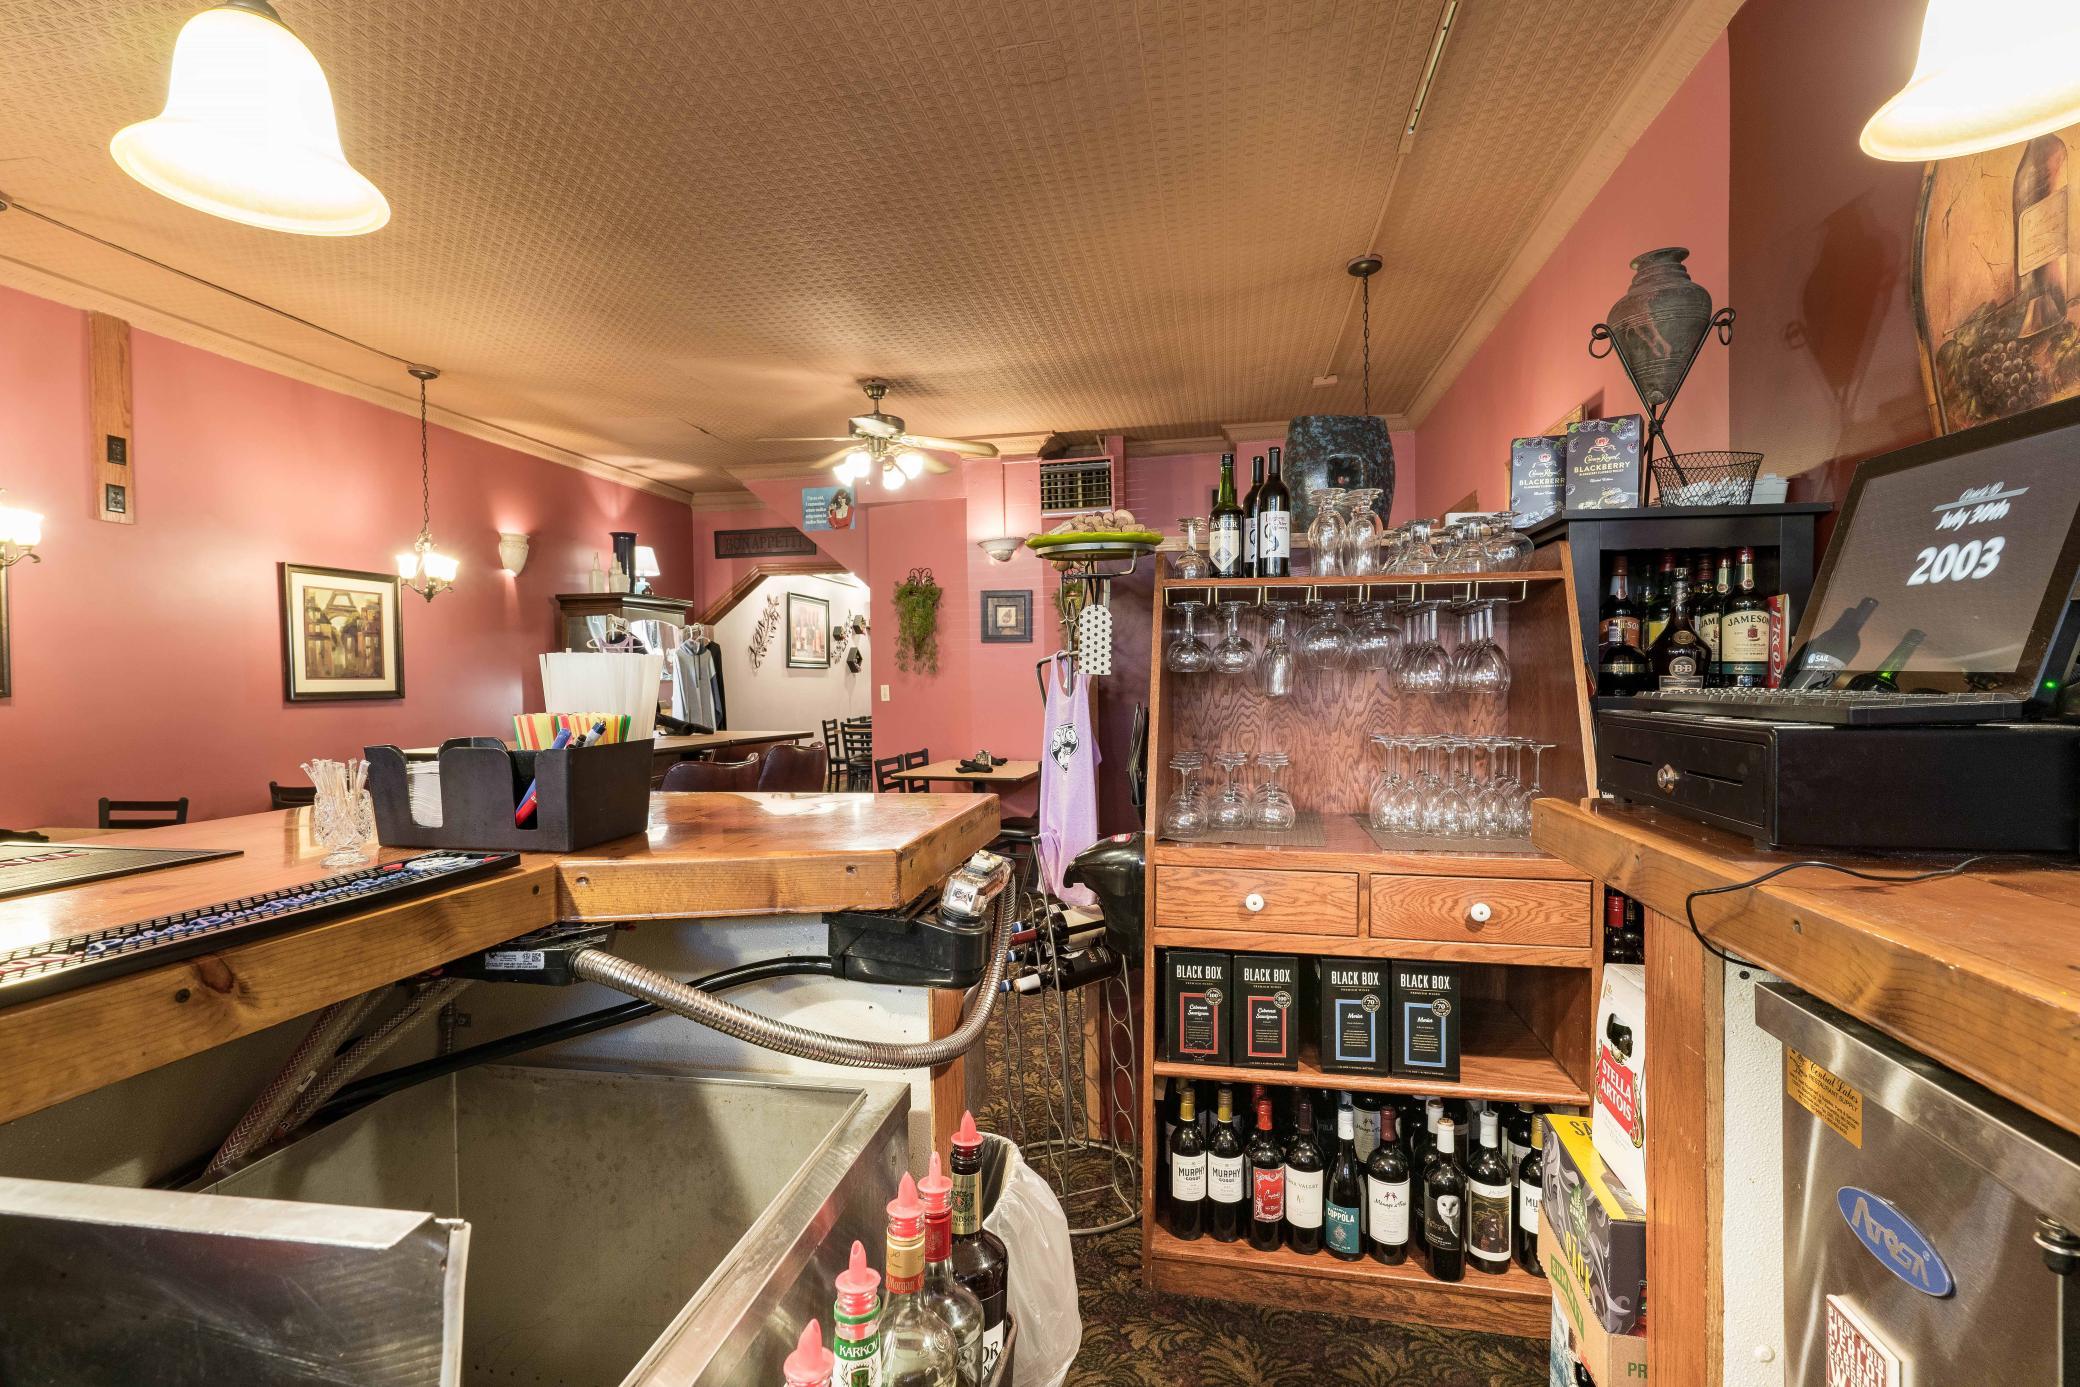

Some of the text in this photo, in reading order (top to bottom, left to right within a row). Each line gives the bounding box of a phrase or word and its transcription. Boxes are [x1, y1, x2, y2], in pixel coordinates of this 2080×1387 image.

[1574, 461, 1631, 474] BLACKBERRY
[1519, 477, 1566, 486] BLACKBERR
[1209, 521, 1238, 530] TAYLOR
[1906, 536, 2006, 586] 2003
[1176, 965, 1223, 980] BLACK BOX
[1244, 968, 1291, 982] BLACK BOX
[1331, 971, 1380, 986] BLACK BOX
[1400, 973, 1451, 990] BLACK BOX
[1601, 1059, 1632, 1103] STELLA
[1600, 1081, 1632, 1122] ARTOIS
[1178, 1166, 1206, 1177] MURPHY
[1212, 1167, 1241, 1178] MURPHY
[1327, 1207, 1355, 1223] COPPOLA
[839, 1338, 878, 1358] KARKOV
[1628, 1362, 1647, 1379] PR
